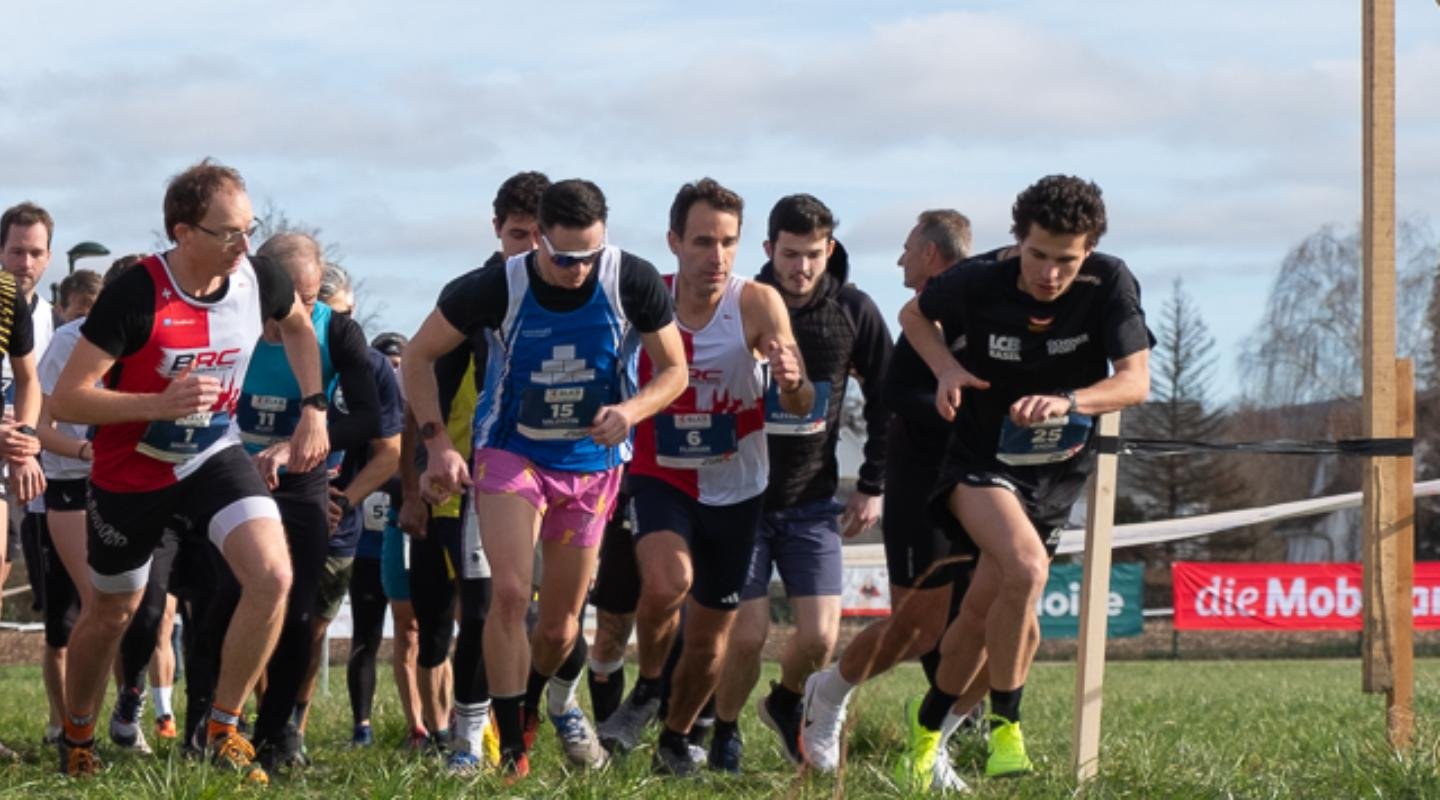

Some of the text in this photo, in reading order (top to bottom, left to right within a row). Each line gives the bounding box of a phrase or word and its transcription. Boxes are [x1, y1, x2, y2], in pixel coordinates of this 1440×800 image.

[170, 348, 241, 372] BRC
[550, 403, 575, 418] 15
[687, 431, 702, 446] 6
[1032, 428, 1063, 443] 25
[1035, 581, 1124, 616] oie
[1195, 576, 1440, 618] die Moba
